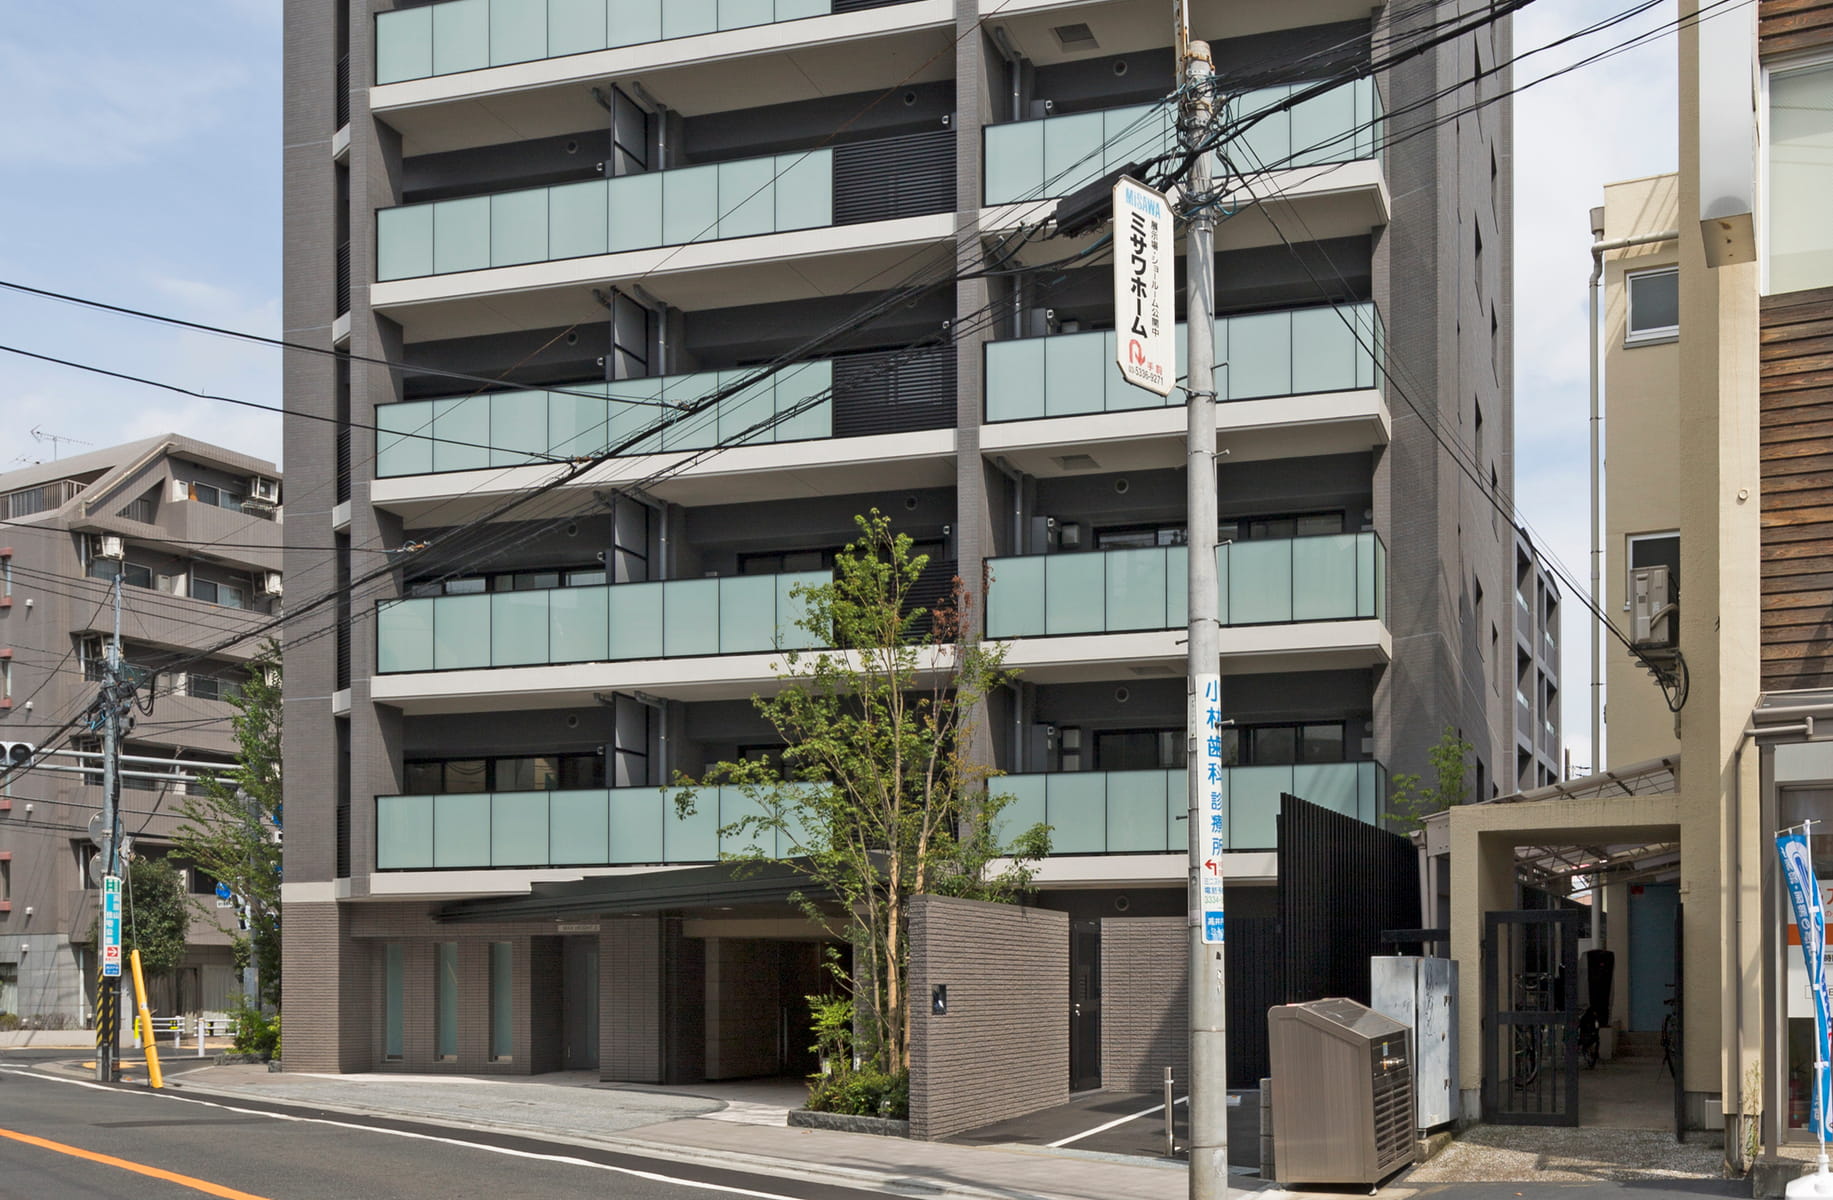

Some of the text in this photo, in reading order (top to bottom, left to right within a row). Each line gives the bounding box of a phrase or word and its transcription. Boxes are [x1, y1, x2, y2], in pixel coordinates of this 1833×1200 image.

[1130, 211, 1148, 339] ミサワホーム
